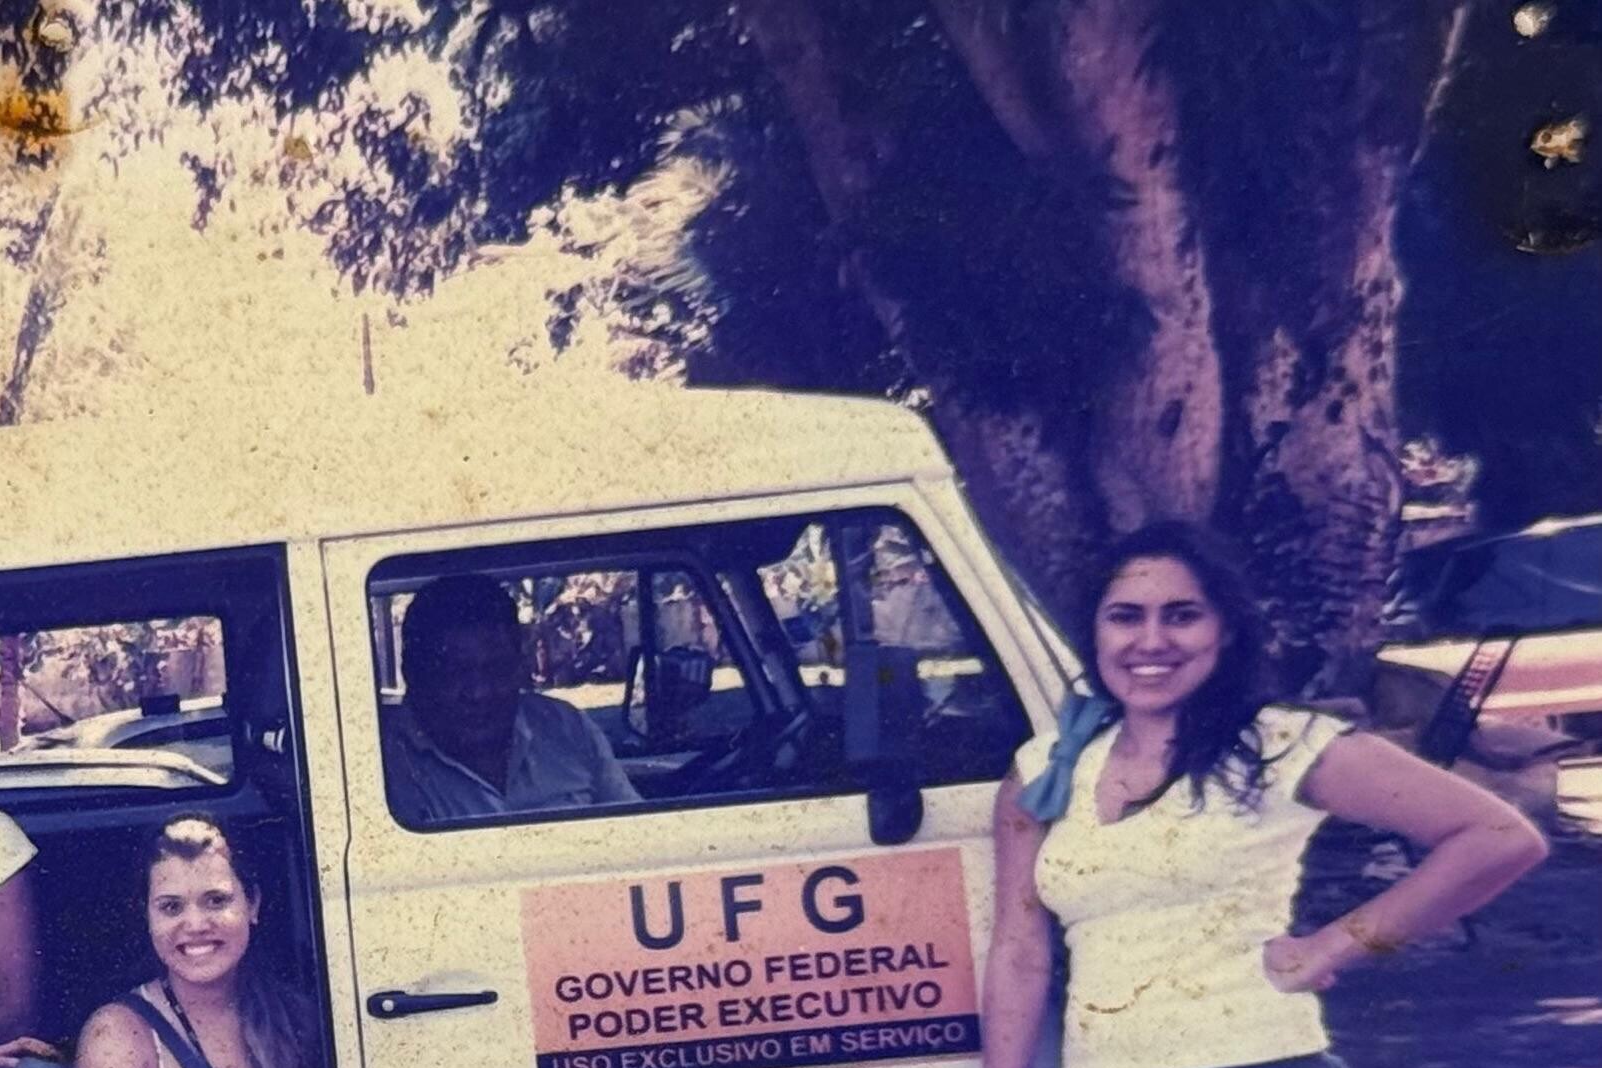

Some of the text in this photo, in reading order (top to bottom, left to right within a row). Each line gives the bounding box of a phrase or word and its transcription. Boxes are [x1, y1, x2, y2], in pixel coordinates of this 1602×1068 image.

[555, 942, 951, 1004] GOVERNO FEDERAL
[568, 980, 942, 1041] PODER EXECUTIVO
[791, 1033, 832, 1056] EM
[841, 1021, 965, 1053] SERVIÇO
